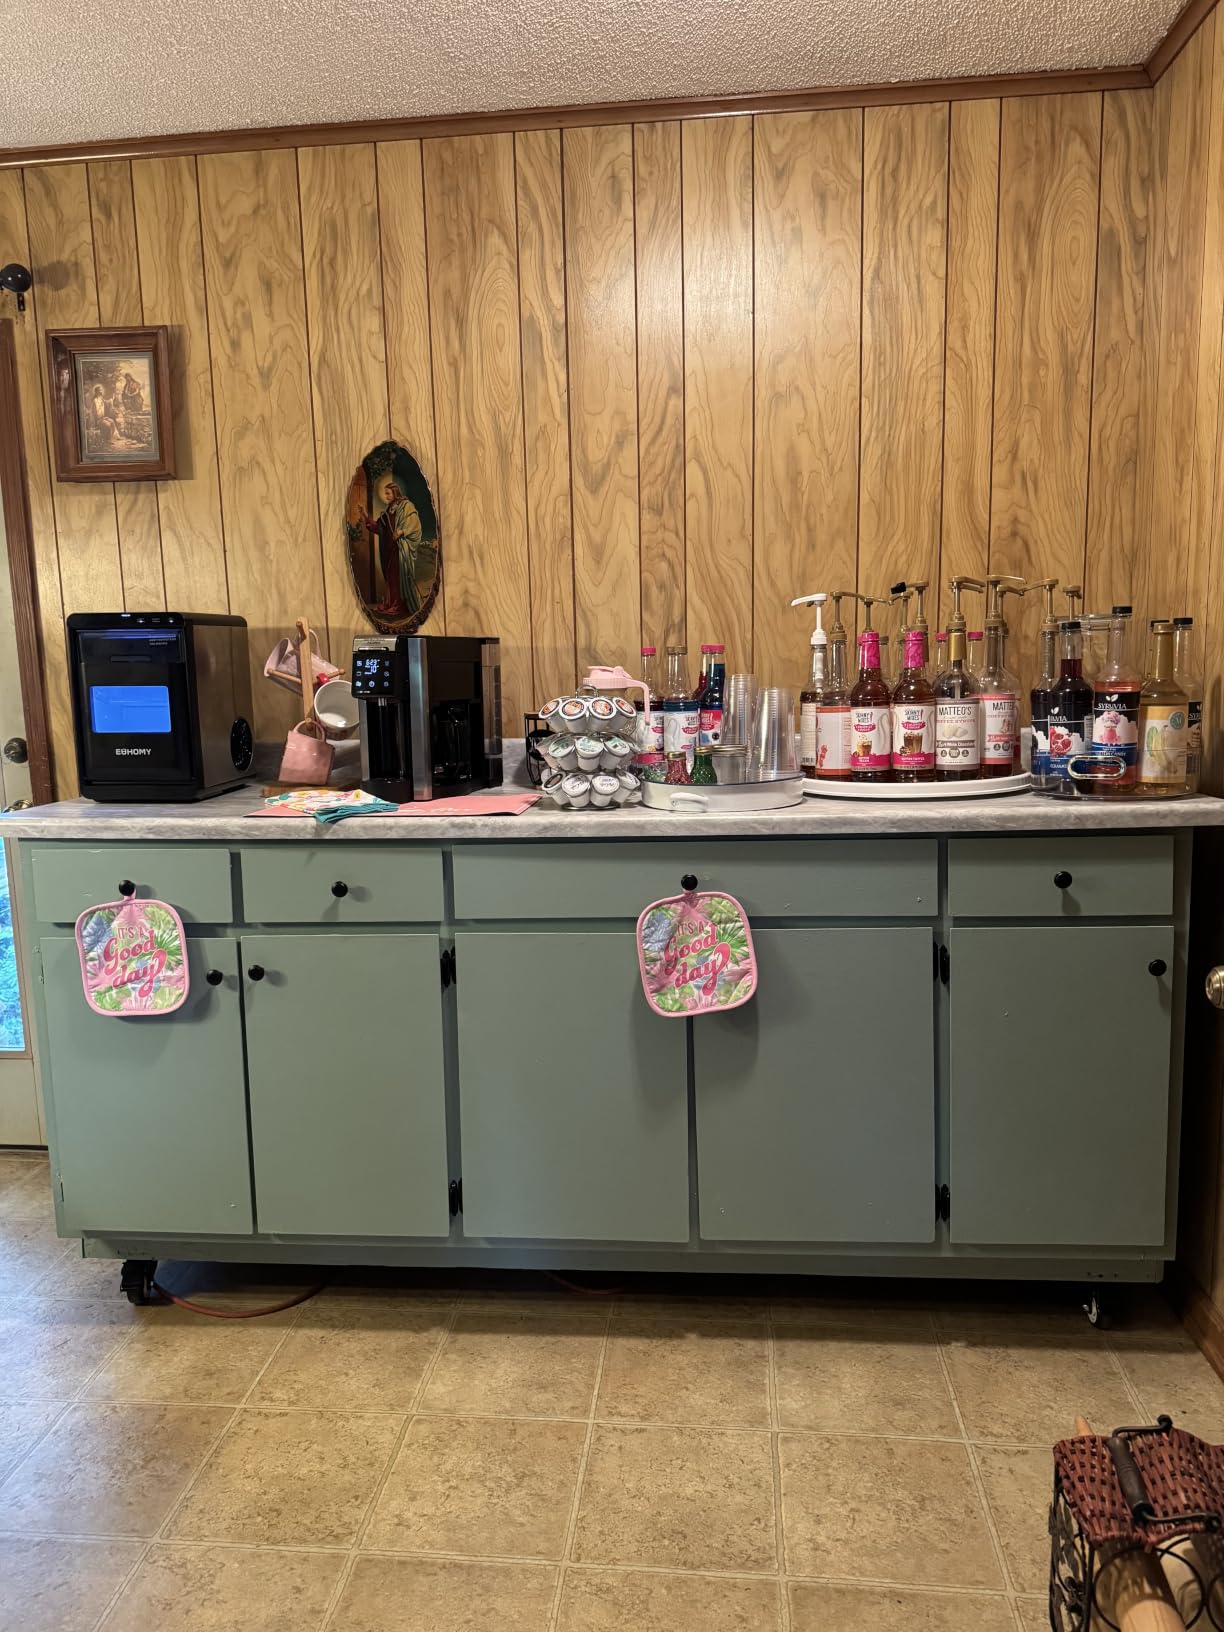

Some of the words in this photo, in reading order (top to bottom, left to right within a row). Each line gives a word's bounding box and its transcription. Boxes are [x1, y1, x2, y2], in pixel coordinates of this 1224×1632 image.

[938, 706, 972, 716] MATTEO'S
[103, 929, 156, 976] Good
[117, 926, 135, 938] IT'S
[664, 922, 718, 976] Good
[677, 922, 694, 936] IT'S
[113, 949, 167, 998] day
[675, 942, 731, 996] day
